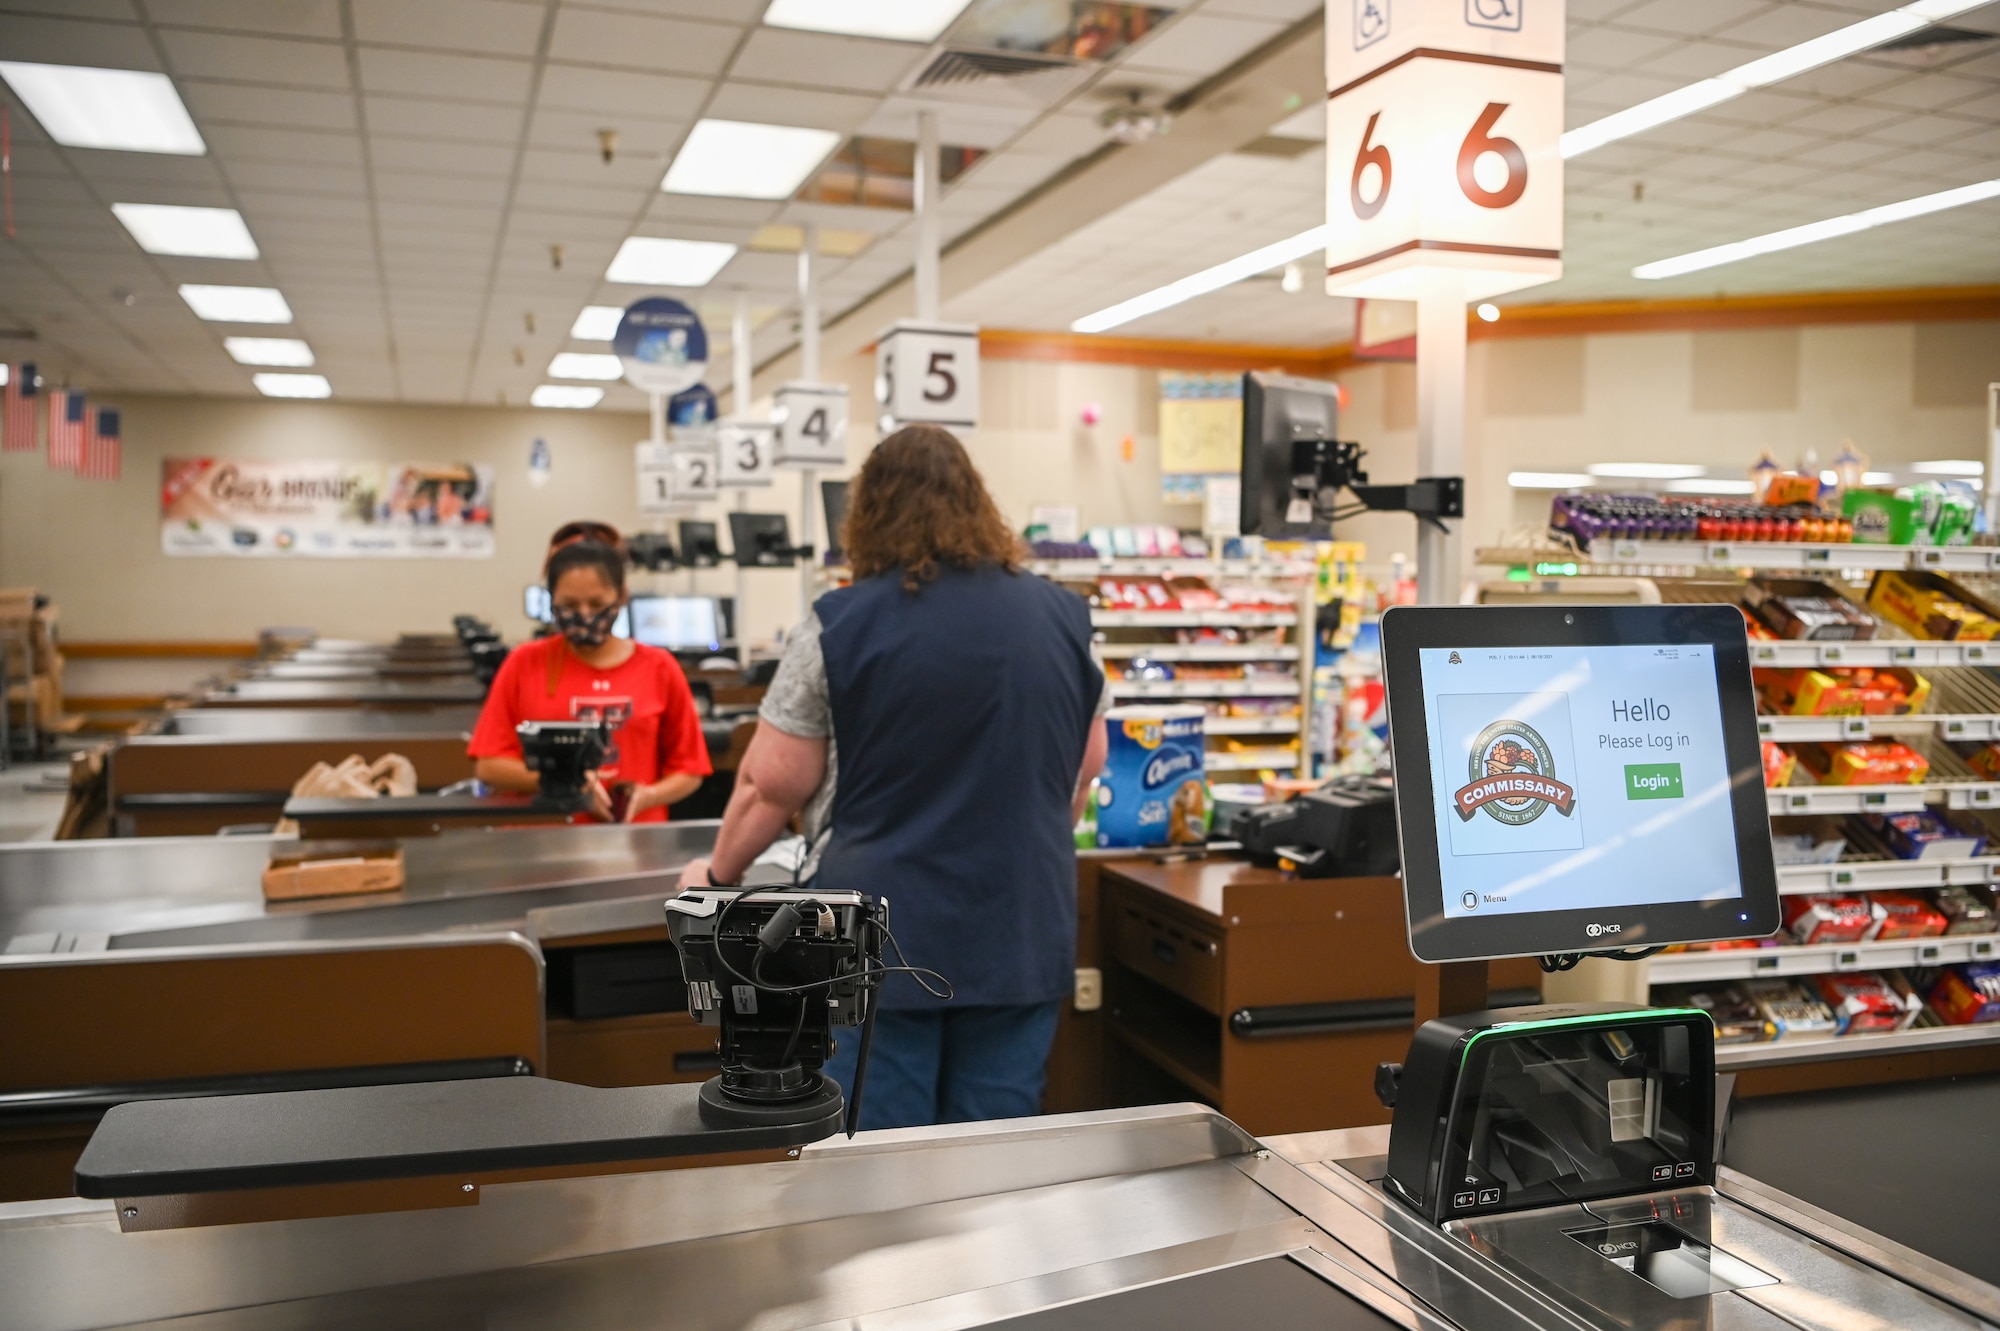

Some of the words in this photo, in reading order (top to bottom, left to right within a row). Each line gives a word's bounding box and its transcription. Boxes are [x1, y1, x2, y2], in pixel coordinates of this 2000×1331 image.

[1350, 110, 1392, 221] 6
[1456, 101, 1528, 209] 6
[923, 352, 957, 402] 5
[802, 407, 830, 446] 4
[738, 438, 760, 471] 3
[689, 460, 707, 488] 2
[657, 477, 667, 499] 1
[1612, 698, 1670, 722] Hello
[1487, 725, 1507, 736] UNITED
[1507, 724, 1526, 733] STATES
[1526, 731, 1541, 747] ARMED
[1539, 746, 1549, 768] FORCES
[1599, 734, 1643, 748] Please
[1647, 733, 1673, 751] Log
[1677, 732, 1690, 746] in
[1463, 779, 1567, 805] COMMISSARY
[1633, 773, 1670, 791] Login
[1498, 811, 1520, 822] SINCE
[1522, 809, 1536, 819] 1867
[1483, 895, 1507, 903] Menu
[1602, 924, 1622, 934] NCR
[1615, 1241, 1639, 1251] NCR
